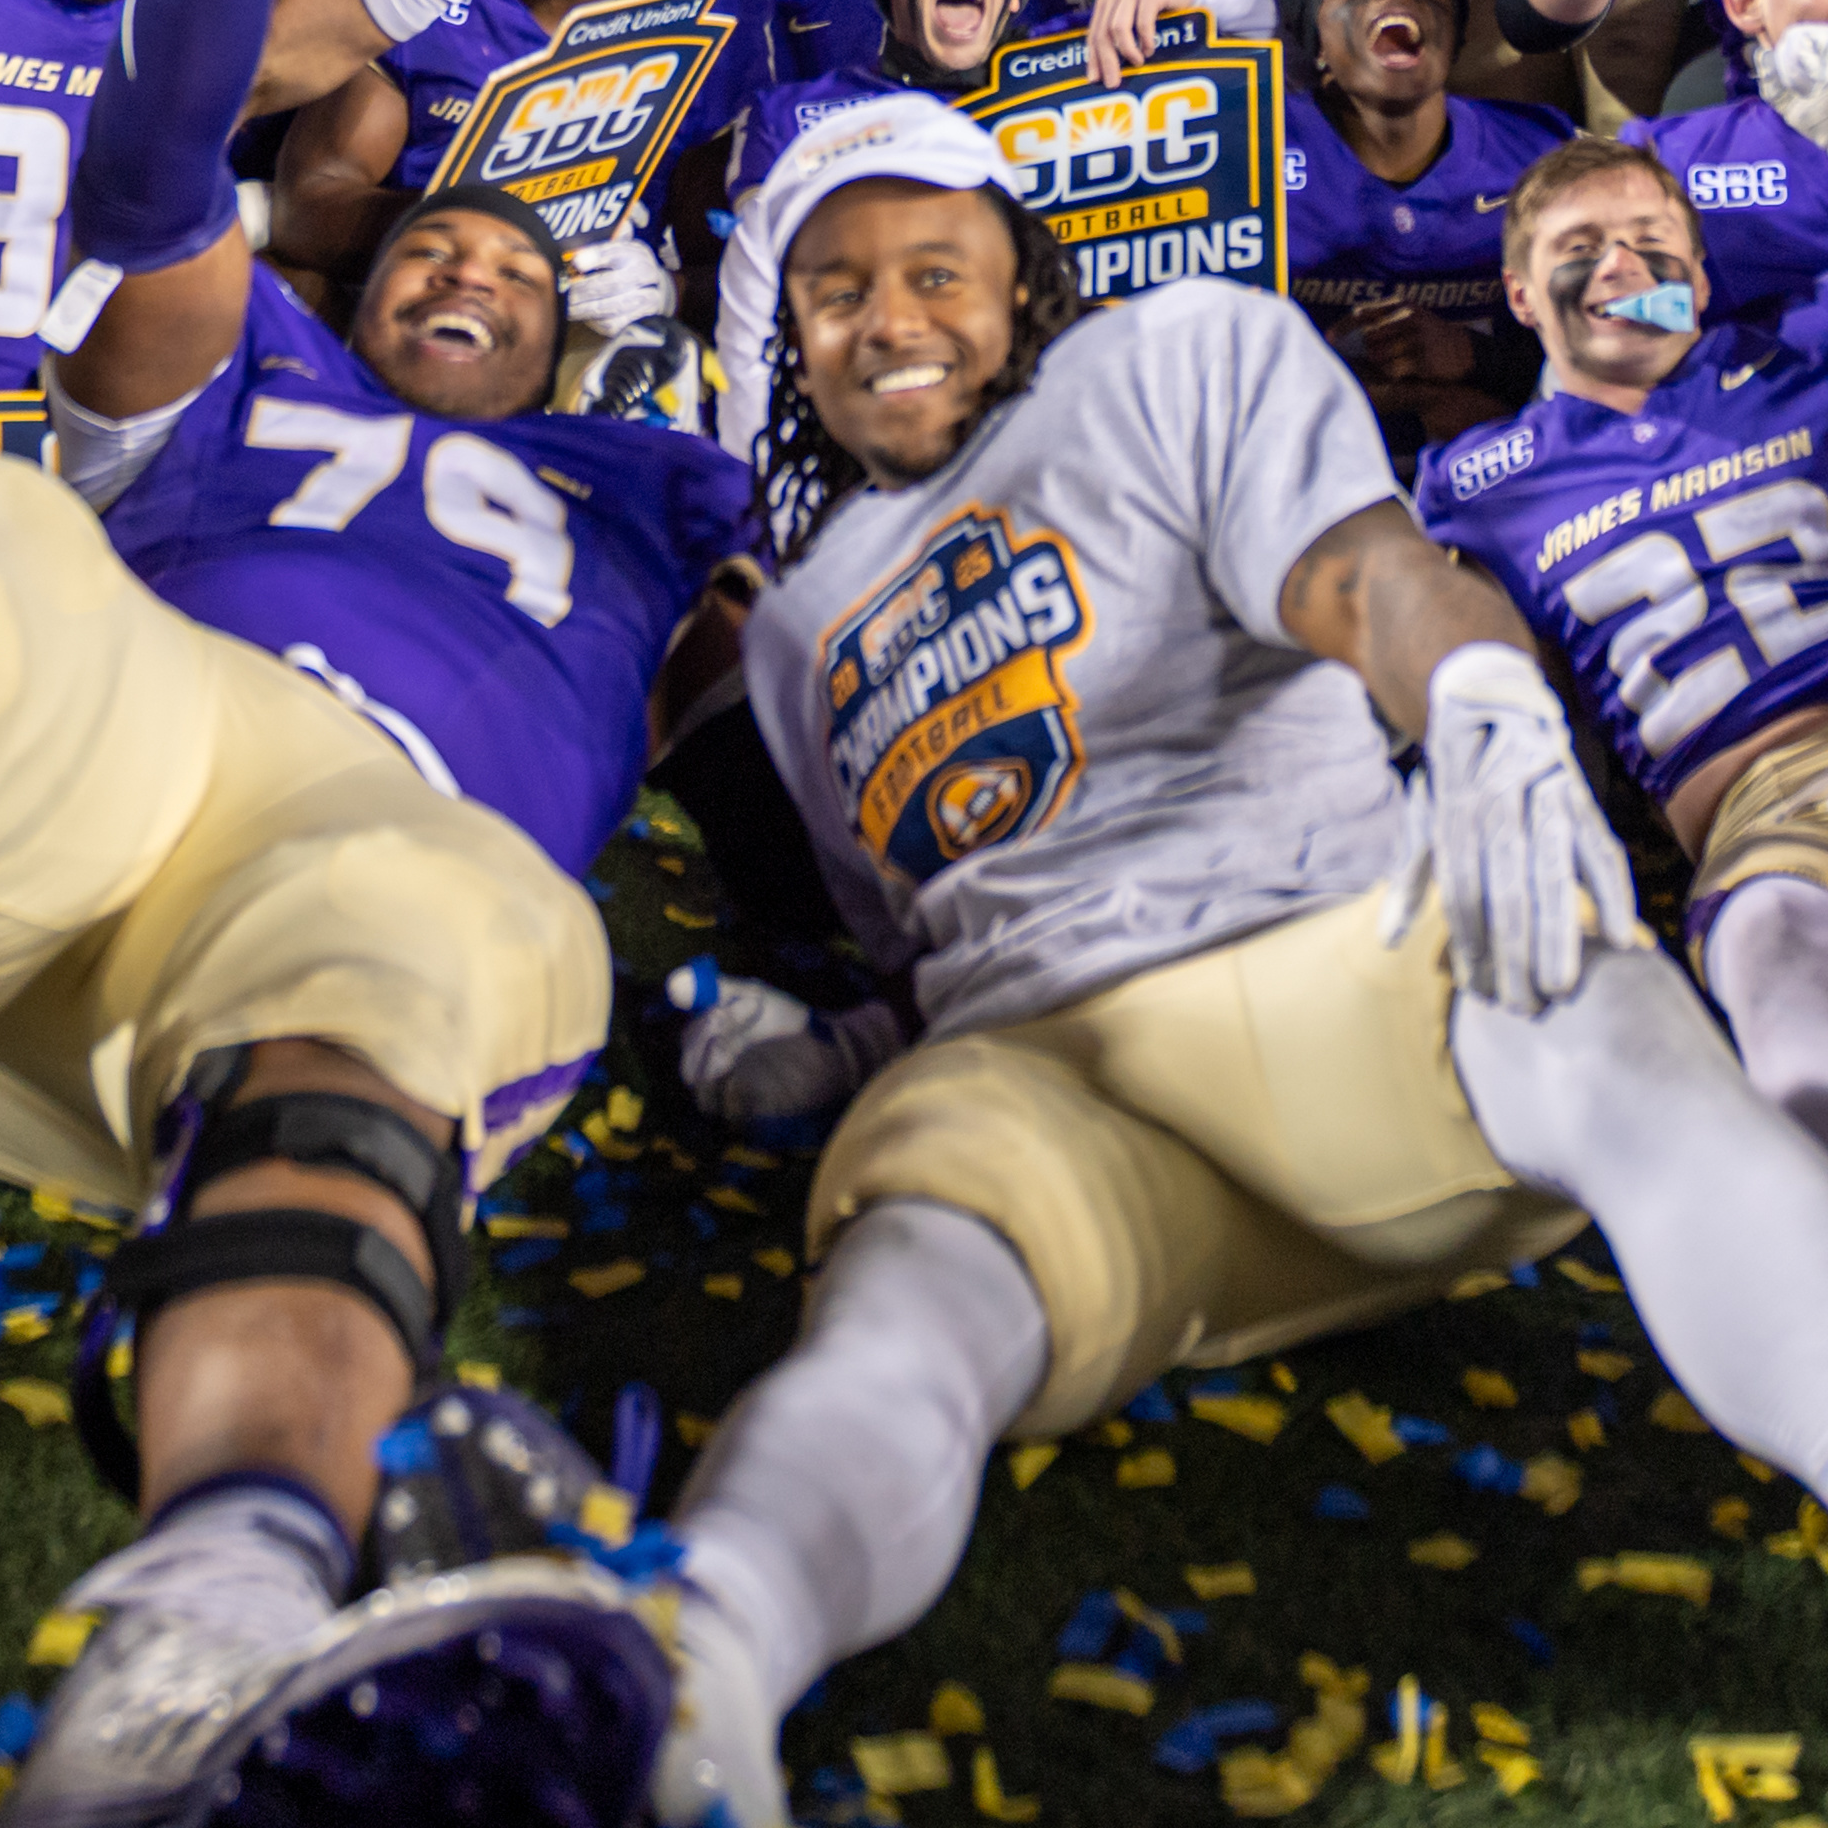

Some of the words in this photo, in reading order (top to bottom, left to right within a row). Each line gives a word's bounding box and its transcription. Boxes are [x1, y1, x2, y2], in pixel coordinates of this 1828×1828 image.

[567, 16, 631, 48] Credit
[630, 1, 690, 33] Union
[481, 51, 680, 182] SBC
[992, 76, 1220, 210] SBC
[508, 162, 616, 202] OTBALL
[1048, 194, 1195, 242] OTBALL
[1687, 161, 1787, 210] SBC
[1077, 215, 1264, 298] PIONS
[1447, 428, 1536, 501] SBC
[1534, 490, 1644, 574] JAMES
[1650, 427, 1814, 509] MADISON
[245, 394, 572, 628] 79
